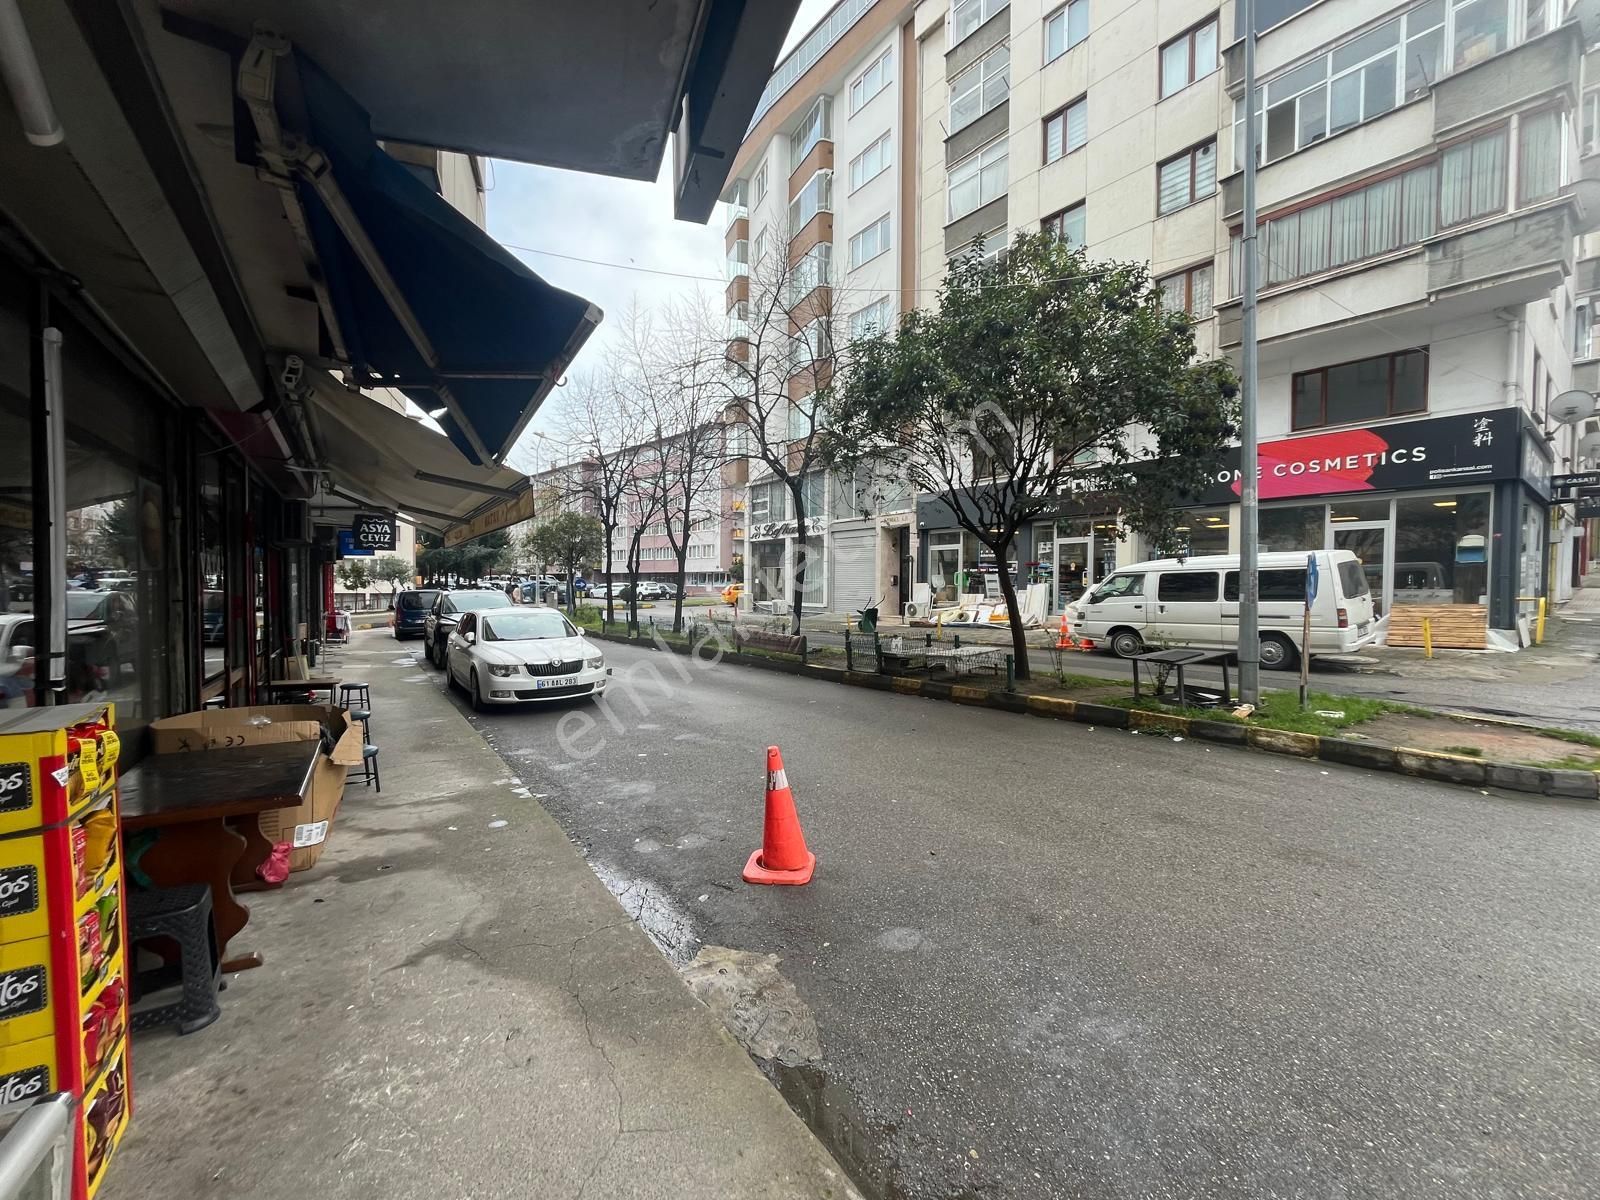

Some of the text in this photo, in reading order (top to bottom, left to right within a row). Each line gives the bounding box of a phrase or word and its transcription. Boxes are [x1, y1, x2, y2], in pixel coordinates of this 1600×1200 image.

[1203, 446, 1427, 485] OME COSMETICS
[360, 523, 391, 533] ASYA
